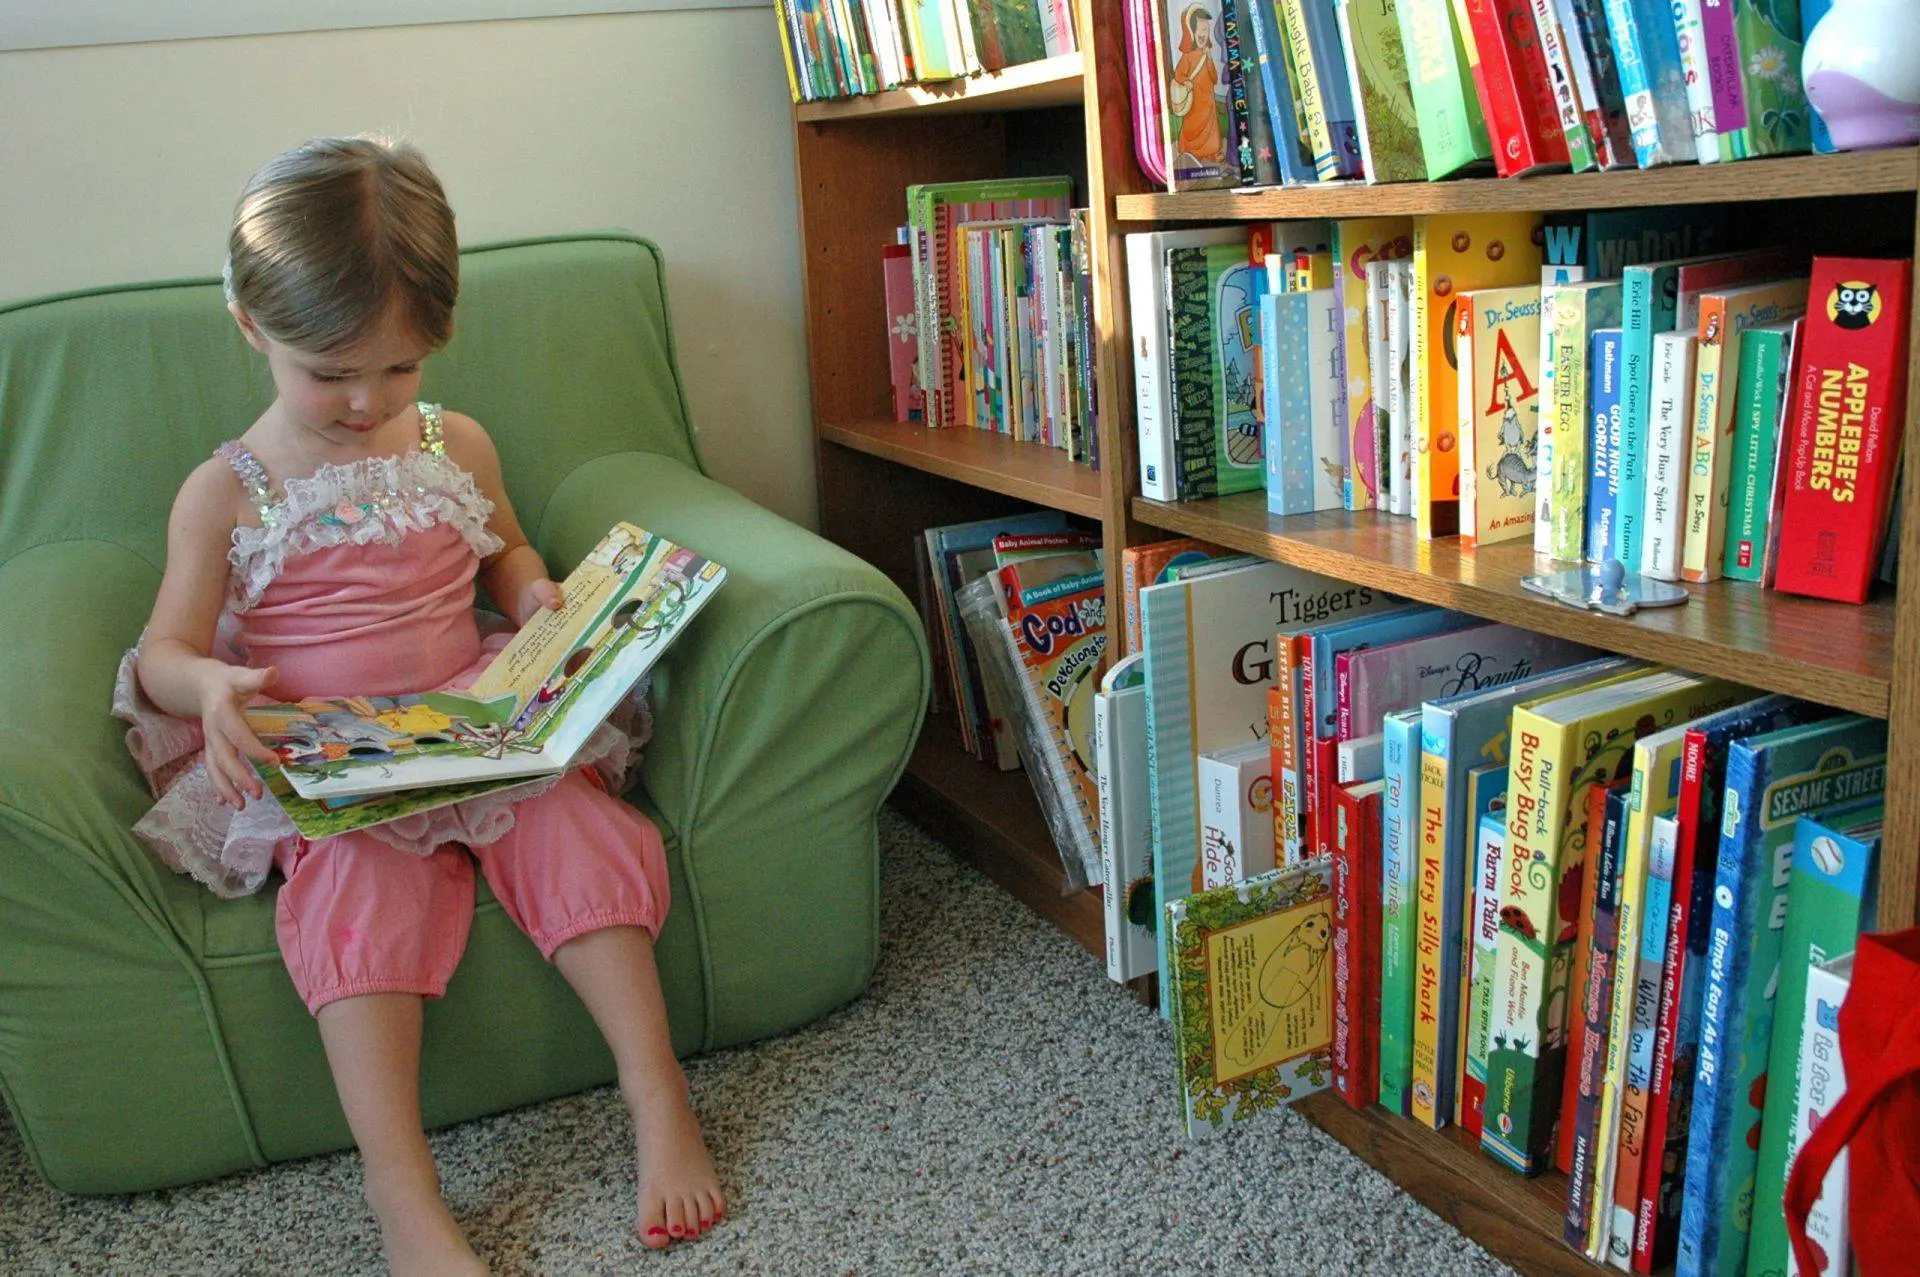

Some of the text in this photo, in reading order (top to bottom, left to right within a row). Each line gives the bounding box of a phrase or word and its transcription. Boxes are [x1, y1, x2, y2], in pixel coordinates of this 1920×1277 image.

[1224, 11, 1249, 116] PAJAMA TIME!
[1300, 61, 1316, 108] Baby
[1712, 56, 1724, 94] BOOKS
[1722, 34, 1739, 108] CATERPILLAR
[1416, 296, 1424, 361] Cheerios
[1485, 298, 1542, 330] Dr. Seuss's
[1485, 328, 1540, 417] A
[1558, 344, 1574, 399] EASTER
[1663, 361, 1672, 384] Carle
[1664, 342, 1673, 359] Eric
[1803, 392, 1814, 408] and
[1805, 374, 1816, 390] Cat
[1558, 402, 1574, 433] EGG
[1610, 403, 1621, 446] GOOD
[1622, 280, 1642, 560] Eric Hill Spot Goes to the Park Putnam
[1661, 398, 1673, 421] The
[1751, 410, 1761, 431] SPY
[1800, 411, 1811, 437] Mouse
[1810, 369, 1844, 490] NUMBERS
[1832, 362, 1869, 503] APPLEBEE'S
[1595, 413, 1608, 478] GORILLA
[1658, 425, 1671, 451] Very
[1692, 373, 1714, 534] Dr. Seuss's ABC Dr. Seuss
[1748, 434, 1760, 472] LITTLE
[1865, 407, 1881, 463] David Pelham
[1654, 452, 1670, 484] Busy
[1794, 470, 1806, 490] Book
[1489, 518, 1501, 532] An
[1653, 486, 1669, 524] Spider
[1743, 474, 1757, 536] CHRISTMAS
[999, 540, 1018, 550] Baby
[1019, 537, 1042, 547] Animal
[1034, 588, 1053, 600] Book
[1053, 584, 1060, 593] of
[1269, 587, 1373, 625] Tiggers
[1021, 603, 1085, 655] God
[1416, 663, 1451, 679] Disney's
[1279, 641, 1292, 766] LITTLE BIG FLAPS
[1147, 725, 1158, 770] GIANT
[1302, 655, 1314, 812] 1001 Things to Spot on the Farm
[1099, 775, 1108, 795] The
[1685, 743, 1699, 783] MOORE
[1213, 778, 1222, 813] Dunrea
[1282, 779, 1297, 841] FARM
[1387, 774, 1402, 809] Ten
[1535, 758, 1554, 837] Pull-back
[1772, 779, 1831, 818] SESAME
[1834, 764, 1887, 801] STREET
[1386, 813, 1402, 857] Tiny
[1509, 731, 1540, 899] Busy Bug Book
[1205, 824, 1221, 874] Hide
[1103, 858, 1112, 910] Caterpillar
[1383, 859, 1401, 919] Fairies
[1482, 841, 1502, 942] Farm Tails
[1418, 807, 1442, 1025] The Very Silly Shark
[1481, 986, 1490, 1006] TAIL
[1507, 946, 1519, 1027] and Fiona Watt
[1517, 960, 1530, 1020] Ben Mantle
[1608, 903, 1630, 1072] Elmo's Big Lift-and-Look Book
[1653, 903, 1682, 1096] The Night Before Christmas
[1699, 927, 1729, 1086] Elmo's Easy As ABC
[1480, 1010, 1489, 1032] SPIN
[1580, 946, 1608, 1098] Mouse House
[1479, 1035, 1488, 1061] BOOK
[1621, 978, 1658, 1157] Who's on the farm?
[1811, 1033, 1834, 1061] is
[1505, 1067, 1515, 1113] Usborne
[1808, 1062, 1831, 1106] for
[1571, 1136, 1587, 1209] HANDPRINT
